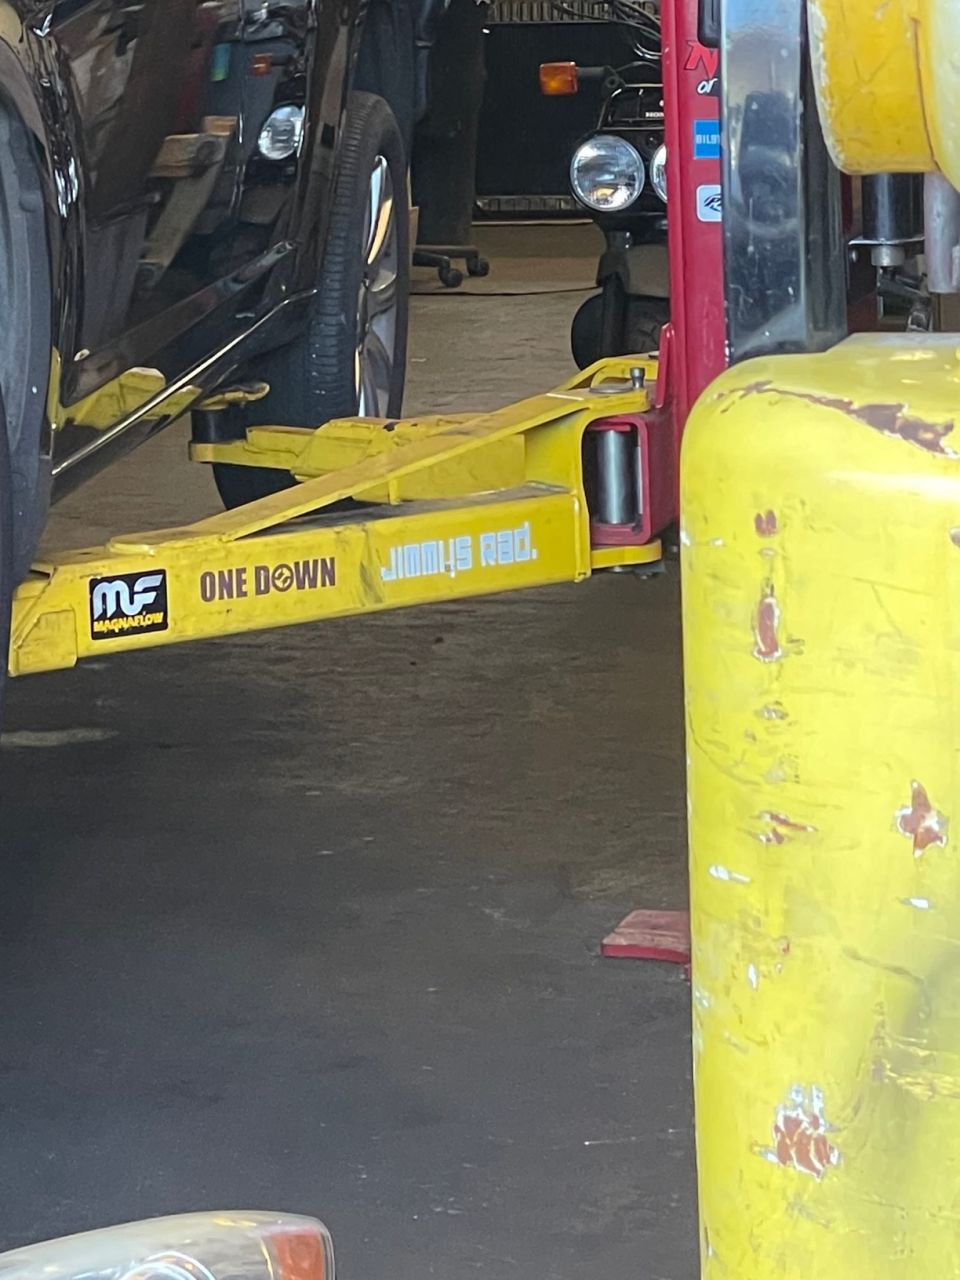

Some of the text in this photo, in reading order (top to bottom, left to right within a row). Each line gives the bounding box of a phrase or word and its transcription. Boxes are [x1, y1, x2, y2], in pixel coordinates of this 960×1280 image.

[92, 574, 164, 620] MF
[200, 556, 336, 602] ONE DOWN
[93, 611, 164, 634] MAGNAFLOW
